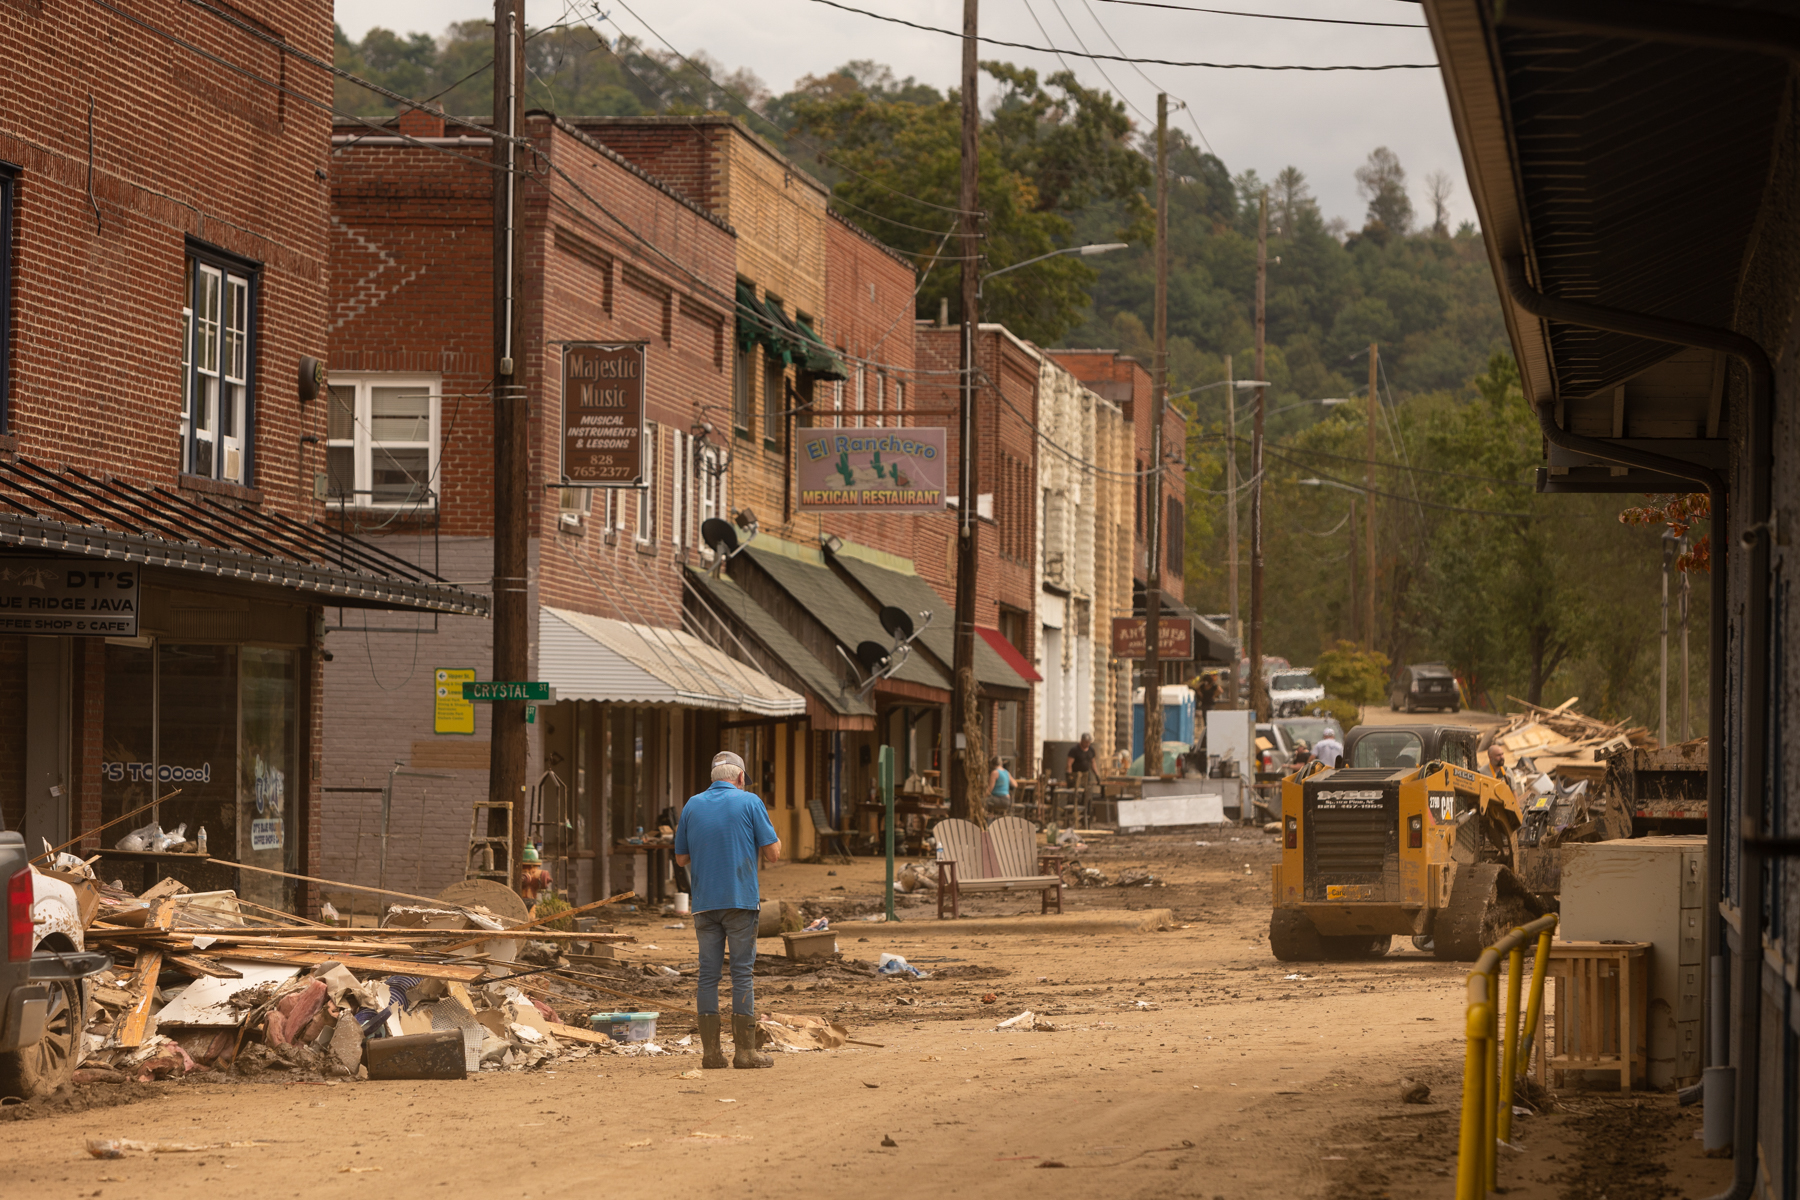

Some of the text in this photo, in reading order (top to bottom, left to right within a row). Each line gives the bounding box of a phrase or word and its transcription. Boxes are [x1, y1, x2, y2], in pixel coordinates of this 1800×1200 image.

[569, 354, 638, 381] Majestic
[579, 383, 628, 407] Music
[580, 415, 624, 425] MUSICAL
[567, 427, 638, 437] INSTRUMENTS
[575, 438, 630, 449] & LESSONS
[805, 433, 938, 462] El Ranchero
[590, 454, 614, 465] 828
[573, 466, 631, 477] 765-2377
[802, 490, 940, 505] MEXICAN RESTAURANT
[28, 597, 86, 610] RIDGE
[90, 598, 134, 612] JAVA
[34, 620, 73, 629] SHOP
[76, 621, 86, 630] &
[473, 684, 530, 698] CRYSTAL
[1441, 796, 1454, 820] CAT
